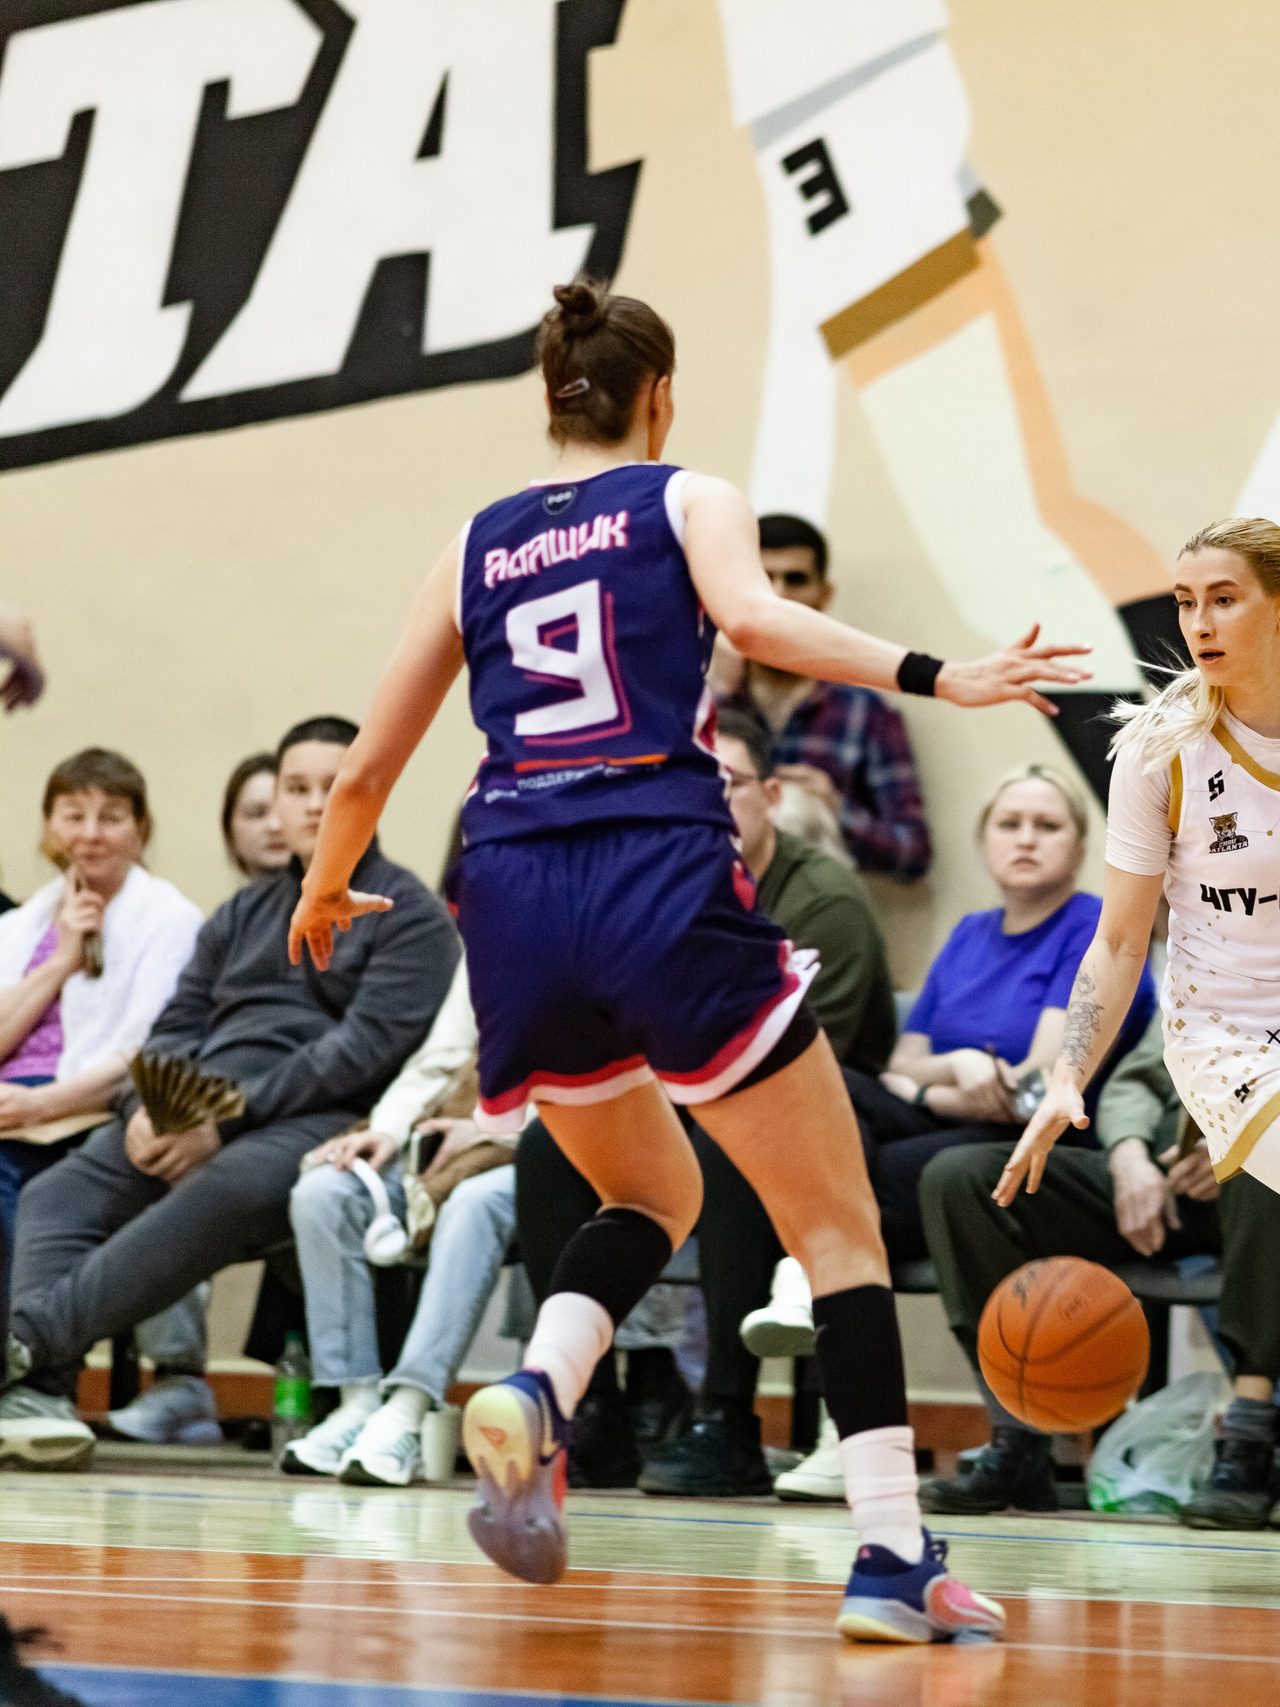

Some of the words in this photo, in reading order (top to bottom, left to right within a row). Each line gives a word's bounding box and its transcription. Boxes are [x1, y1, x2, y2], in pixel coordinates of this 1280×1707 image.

[781, 137, 850, 236] 3
[505, 577, 622, 738] 9
[1211, 841, 1248, 853] ATLANTA
